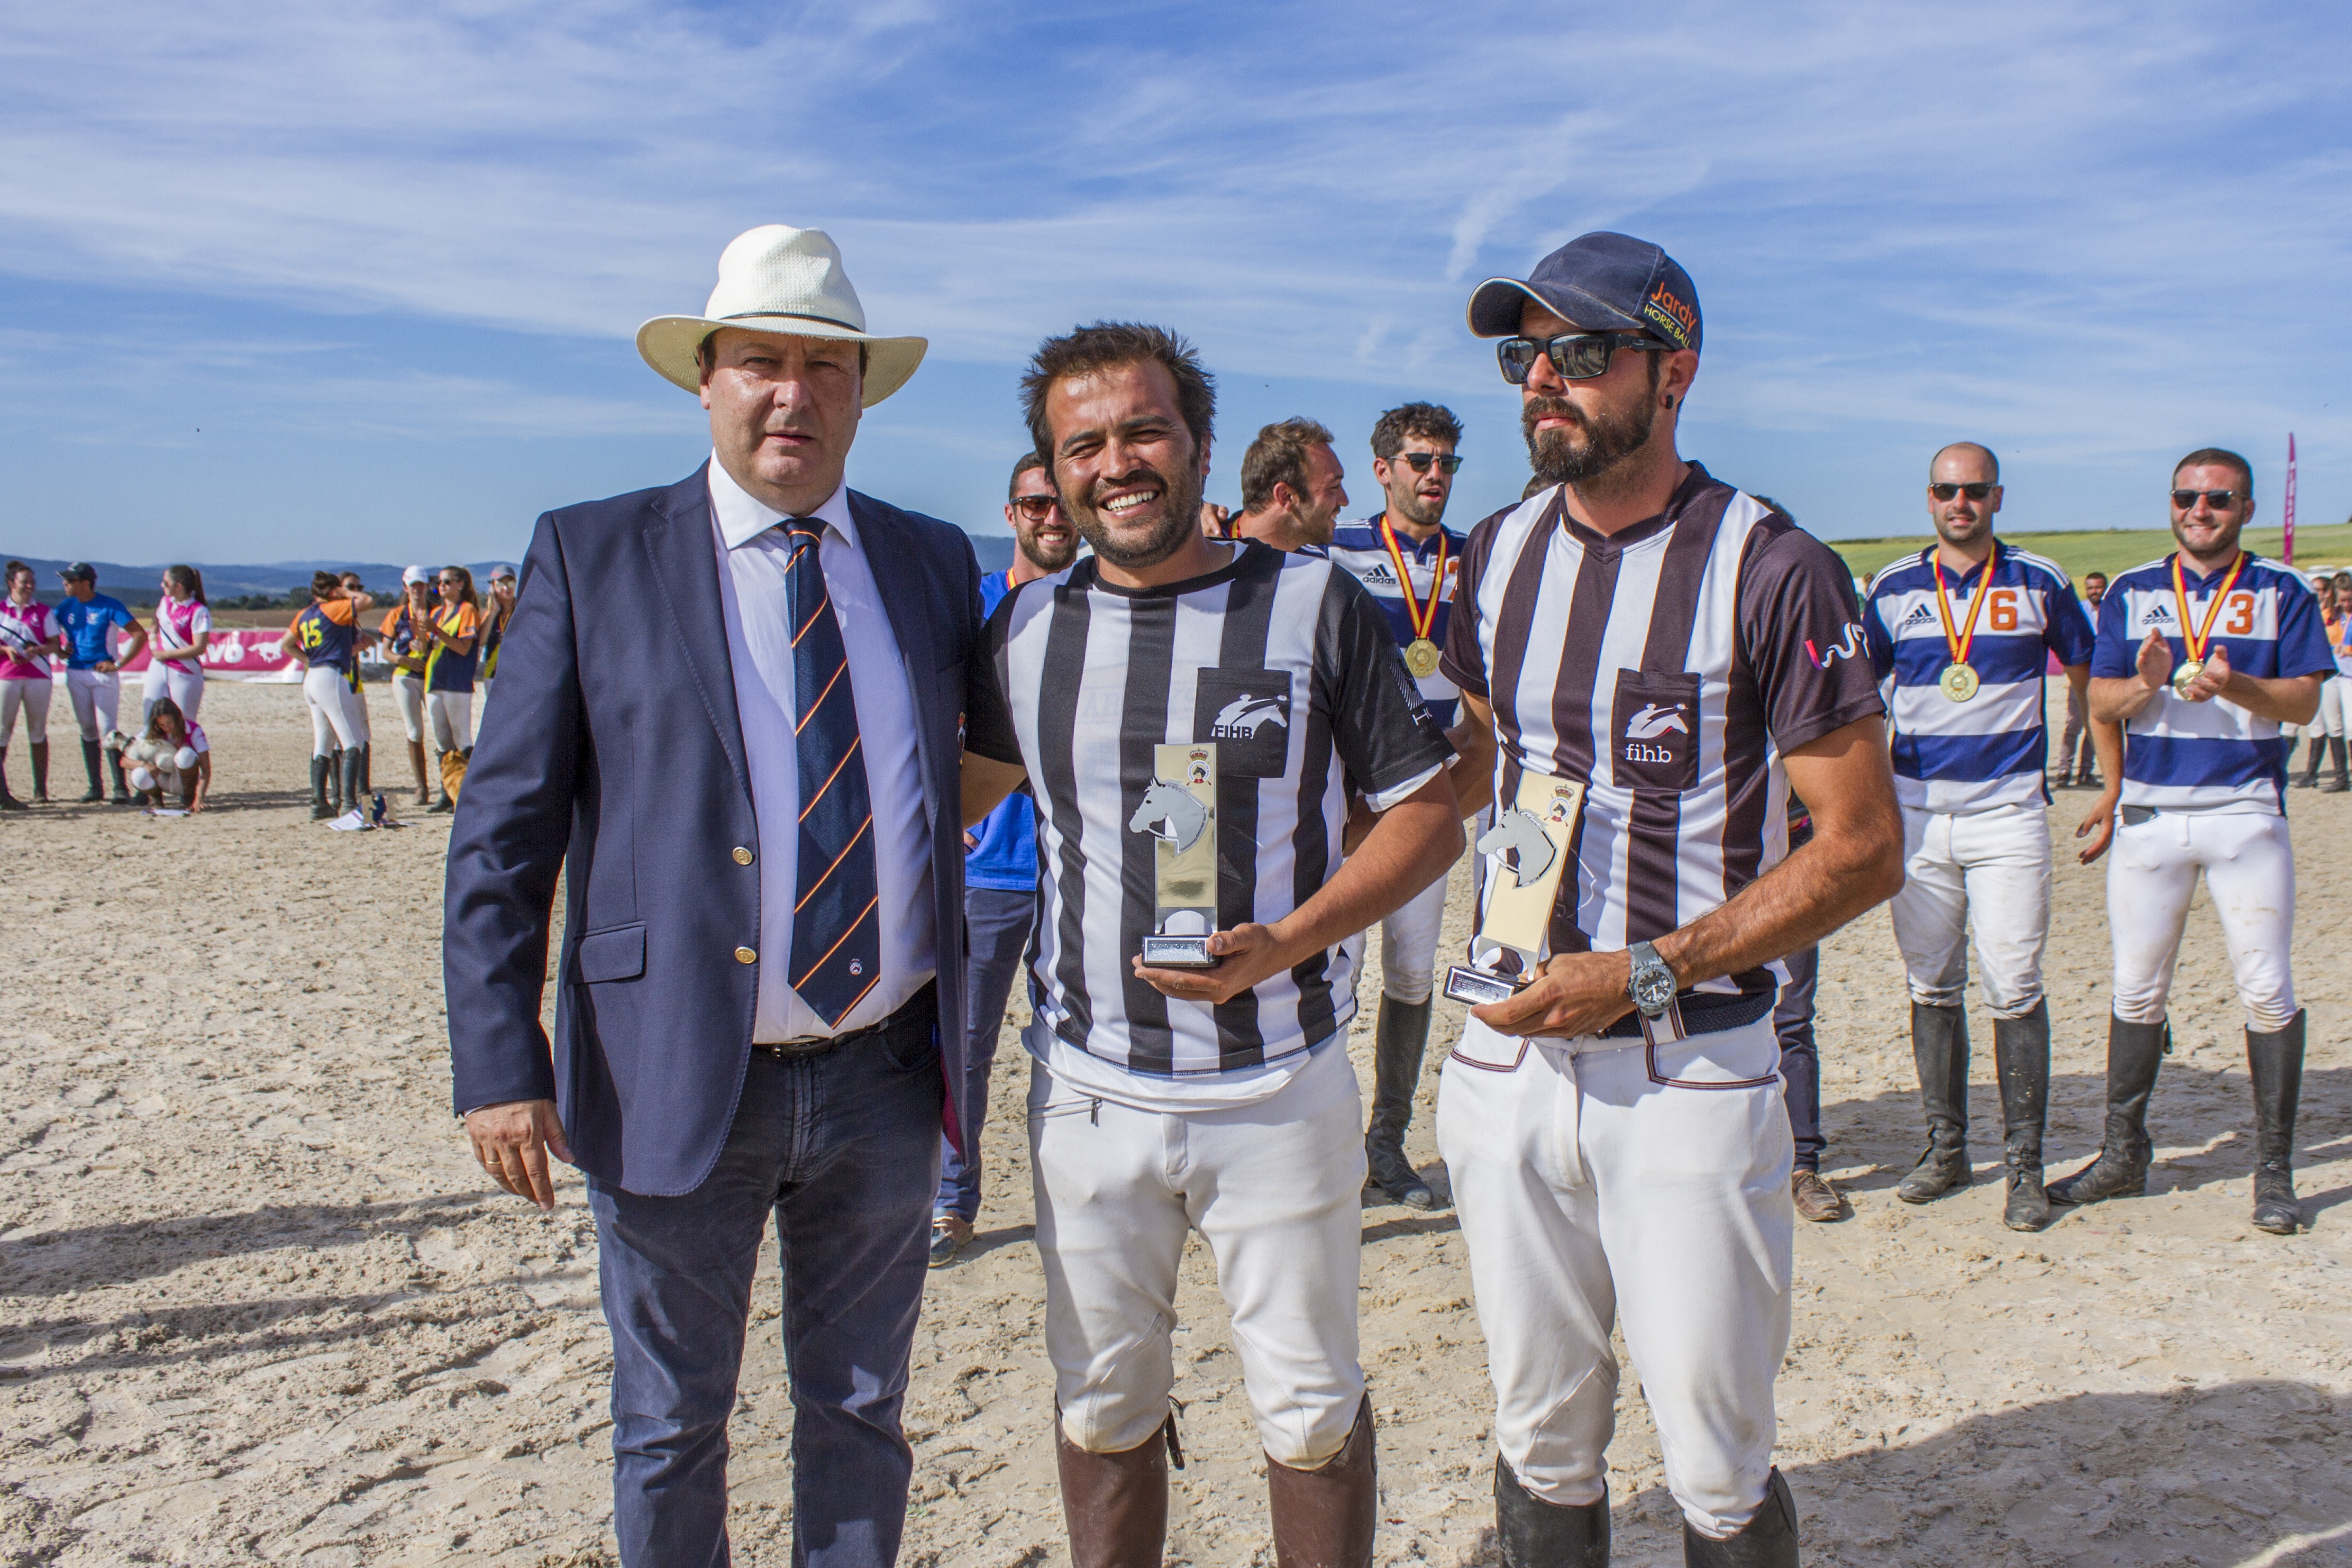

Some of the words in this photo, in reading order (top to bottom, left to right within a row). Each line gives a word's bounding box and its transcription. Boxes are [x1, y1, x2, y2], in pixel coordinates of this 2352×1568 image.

[1651, 281, 1697, 334] Jardy
[1644, 304, 1675, 333] HORSE
[1363, 576, 1396, 585] adidas
[67, 613, 75, 625] 6
[1990, 590, 2017, 631] 6
[2226, 594, 2254, 635] 3
[1905, 617, 1937, 625] adidas
[2142, 617, 2175, 625] adidas
[299, 617, 323, 650] 15
[1215, 725, 1252, 739] FIHB
[1625, 743, 1673, 763] fihb
